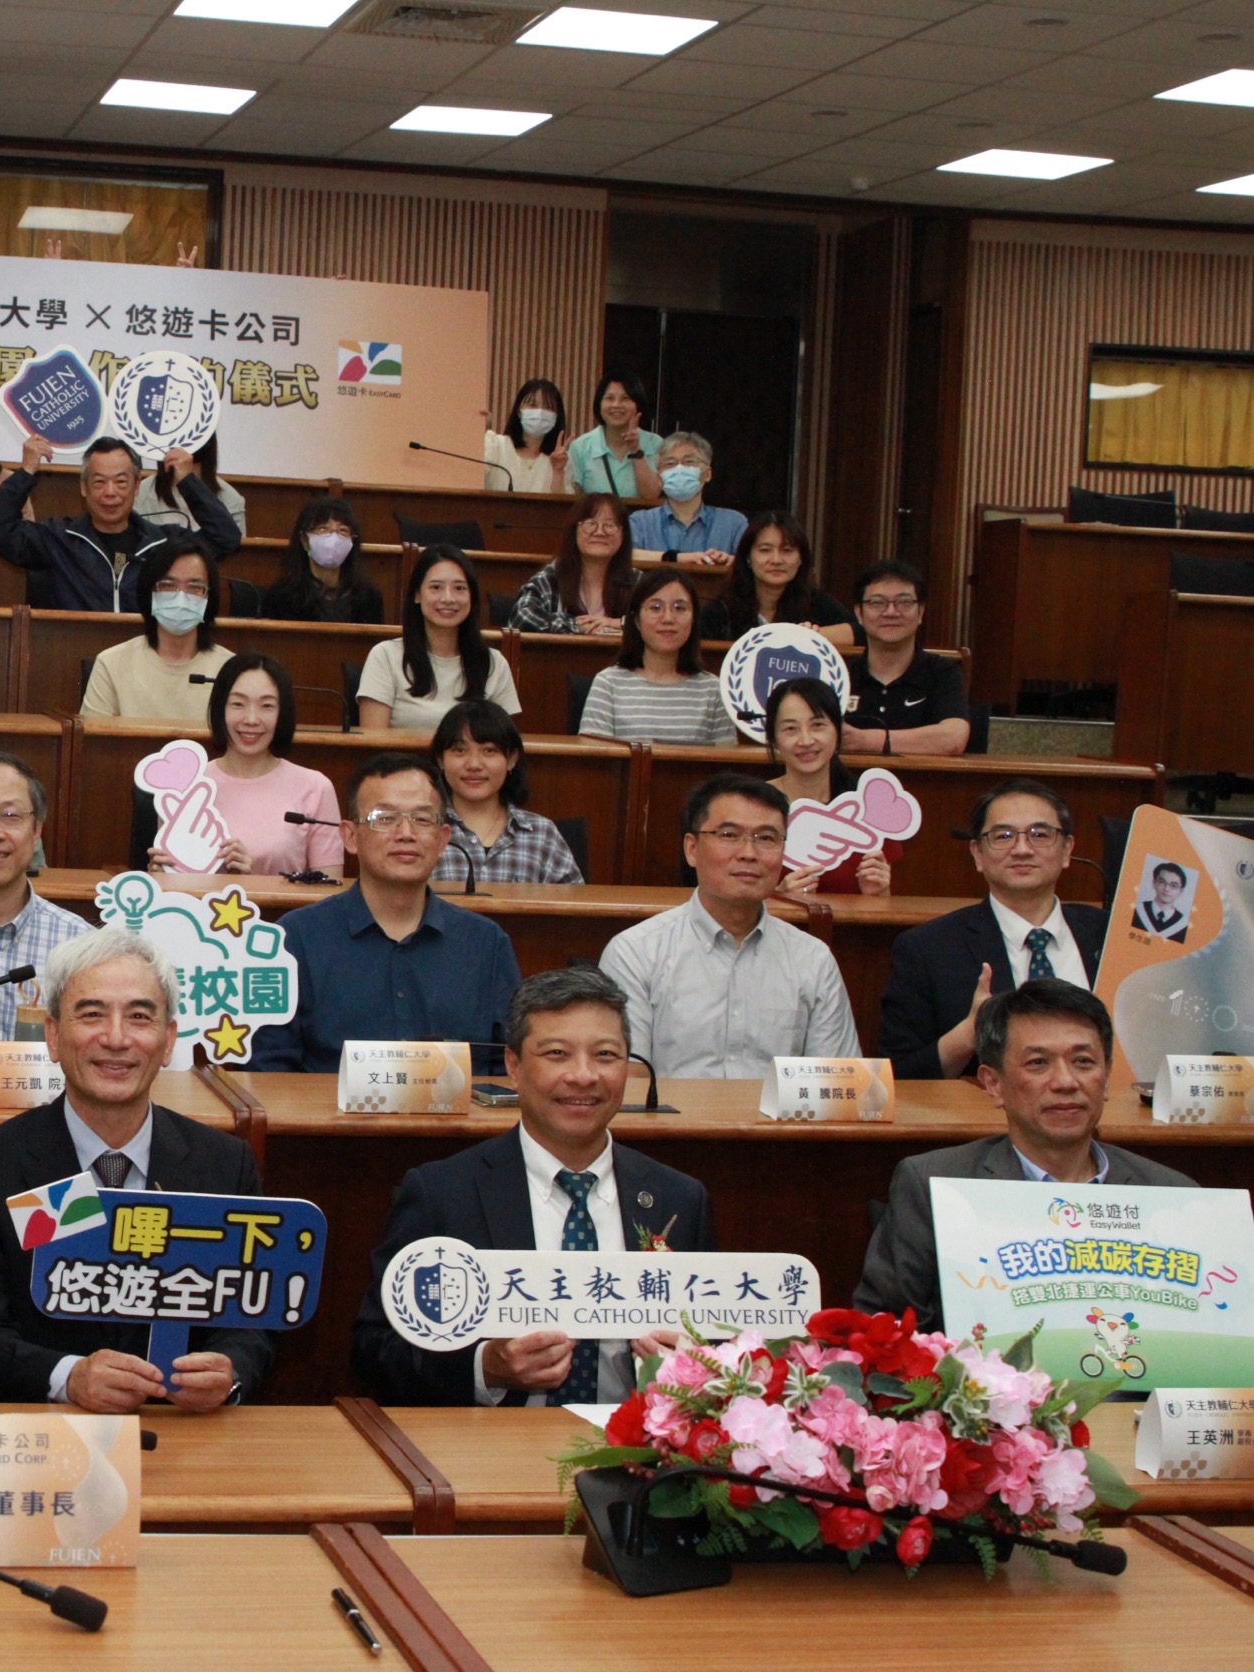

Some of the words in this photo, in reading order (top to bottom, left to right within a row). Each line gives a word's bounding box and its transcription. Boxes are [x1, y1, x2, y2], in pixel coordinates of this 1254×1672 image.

[125, 304, 300, 346] 悠遊卡公司
[18, 364, 77, 412] FUJEN
[30, 379, 85, 422] CATHOLIC
[35, 389, 90, 431] UNIVERSITY
[66, 415, 84, 431] 1925
[768, 656, 810, 674] FUJEN
[176, 965, 289, 1016] 校園
[1087, 1202, 1140, 1220] 悠遊付
[1090, 1219, 1141, 1231] EasyWallet
[998, 1239, 1201, 1286] 我的減碳存摺
[496, 1265, 809, 1306] 天主教輔仁大學
[498, 1307, 559, 1327] FUJEN
[573, 1307, 677, 1325] CATHOLIC
[692, 1309, 809, 1325] UNIVERSITY
[49, 1548, 102, 1562] FUJEN
